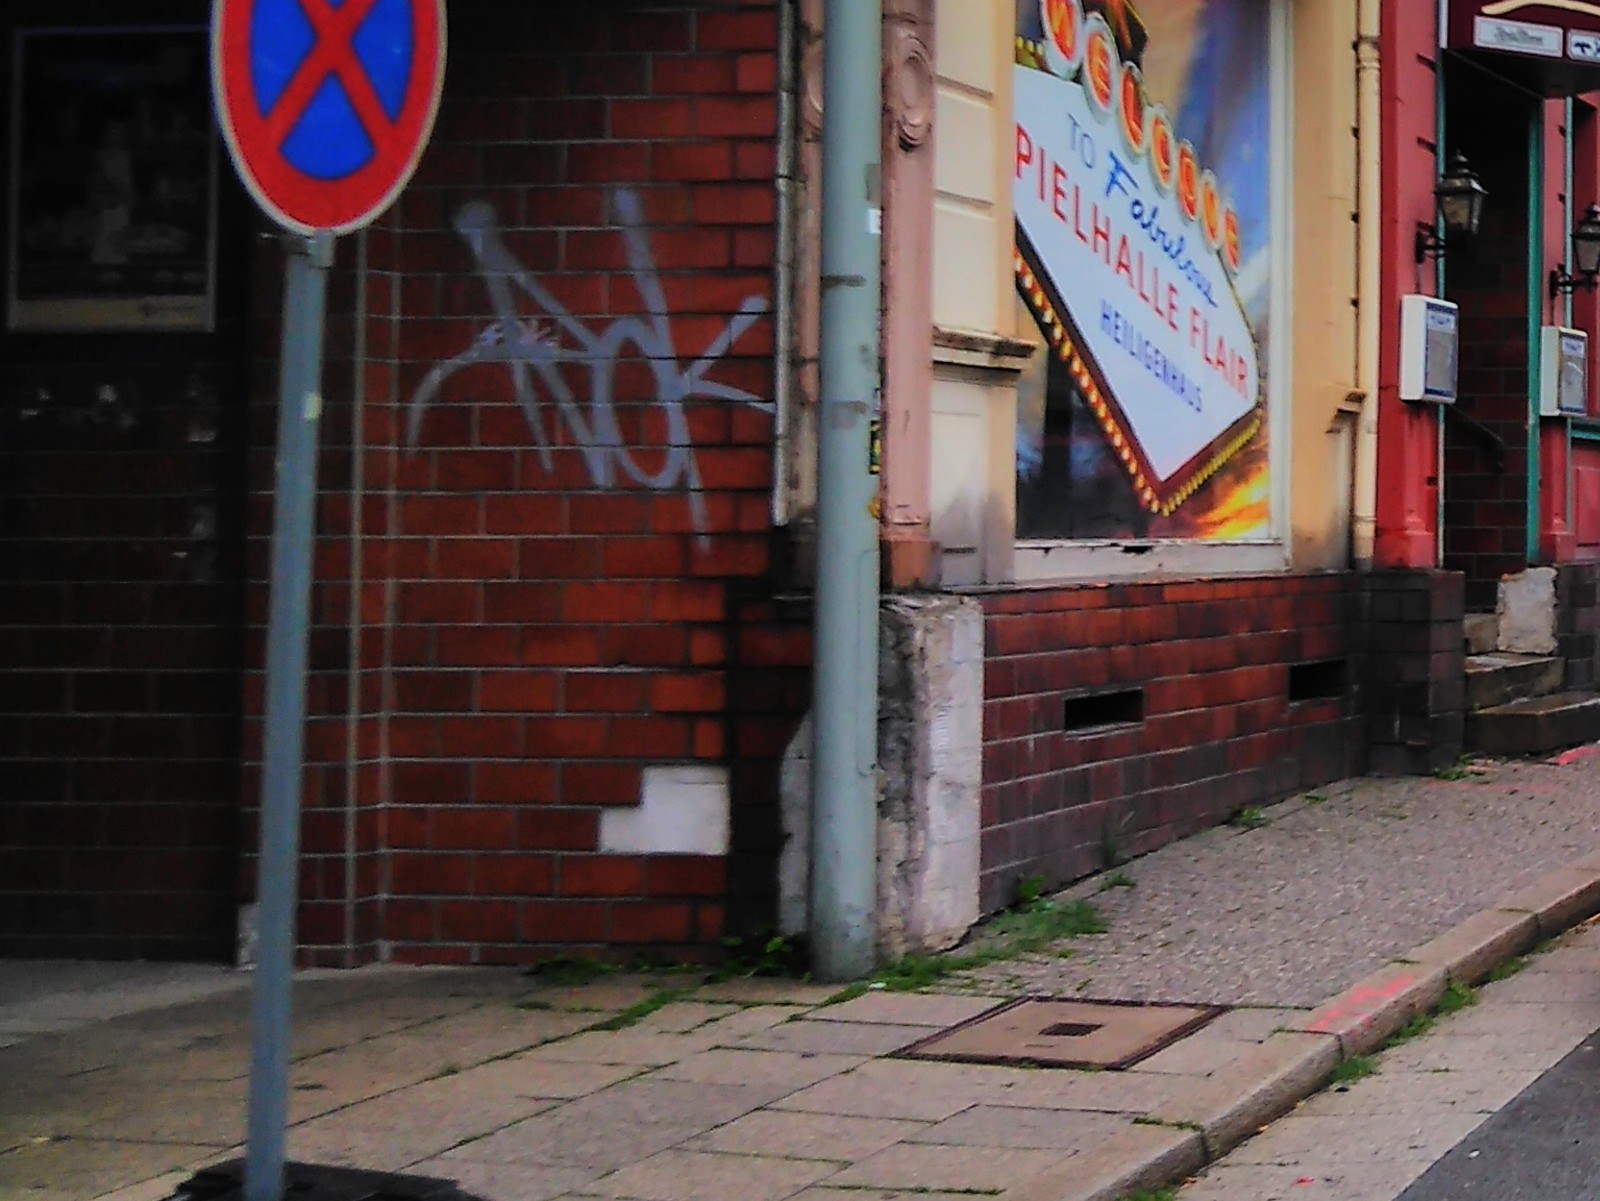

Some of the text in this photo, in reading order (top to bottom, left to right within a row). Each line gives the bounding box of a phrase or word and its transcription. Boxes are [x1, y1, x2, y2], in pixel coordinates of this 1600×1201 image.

[1067, 112, 1097, 169] TO
[1015, 121, 1250, 400] PIELHALLE FLAIR
